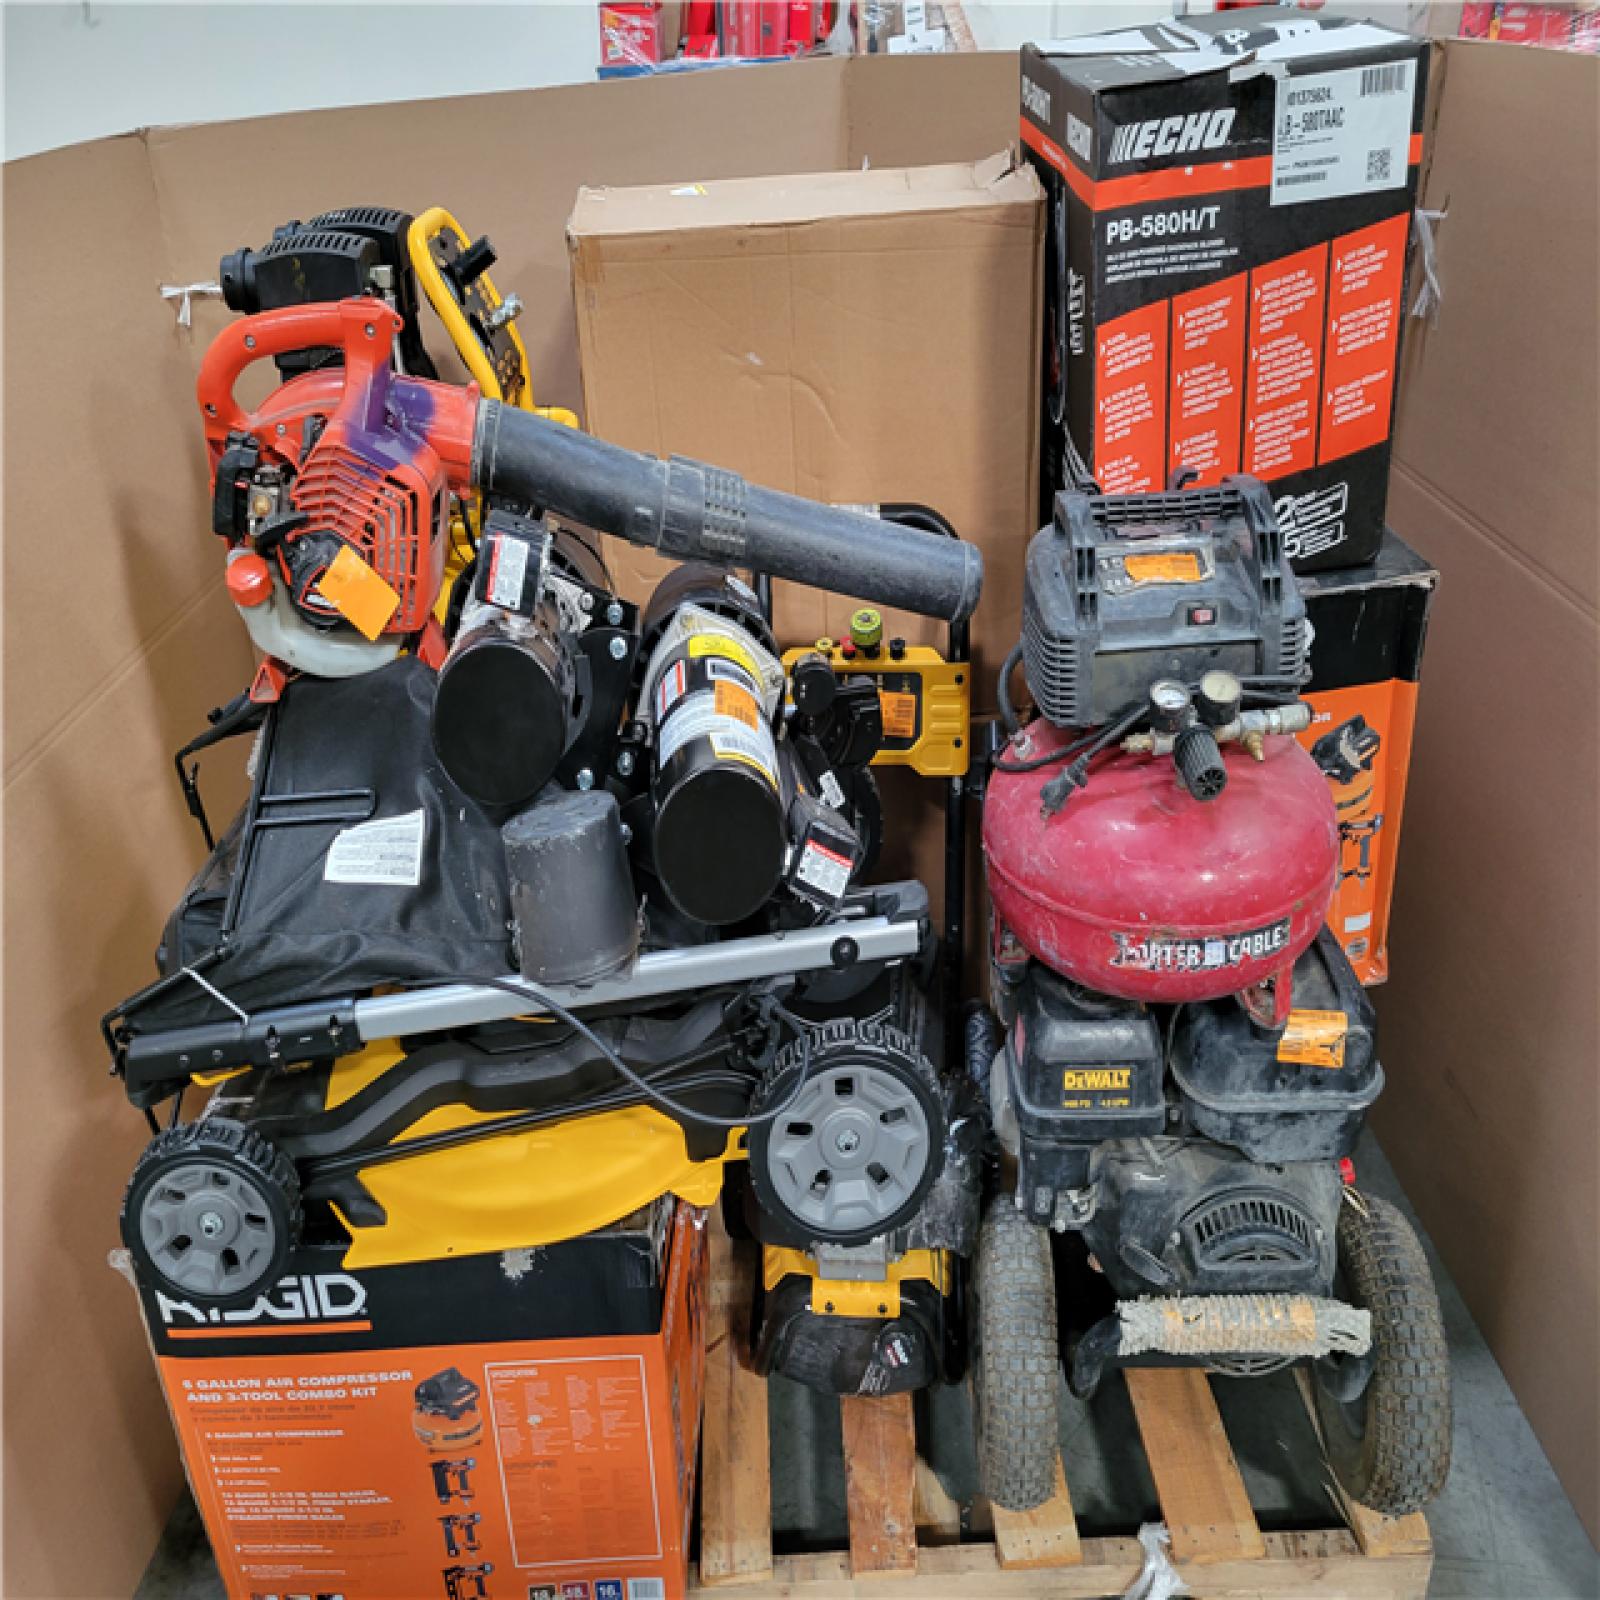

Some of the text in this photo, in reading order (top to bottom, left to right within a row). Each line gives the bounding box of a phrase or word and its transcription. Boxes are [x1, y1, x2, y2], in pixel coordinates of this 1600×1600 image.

[1132, 107, 1237, 158] ECHO
[1106, 205, 1221, 246] PB-580H/T
[1229, 927, 1282, 960] CABLE
[1064, 1070, 1131, 1090] DEWALT
[196, 1377, 261, 1390] GALLON
[266, 1376, 294, 1388] AIR
[297, 1369, 414, 1386] COMPRESSOR
[187, 1386, 378, 1403] AND 3-TOOL COMBO KIT
